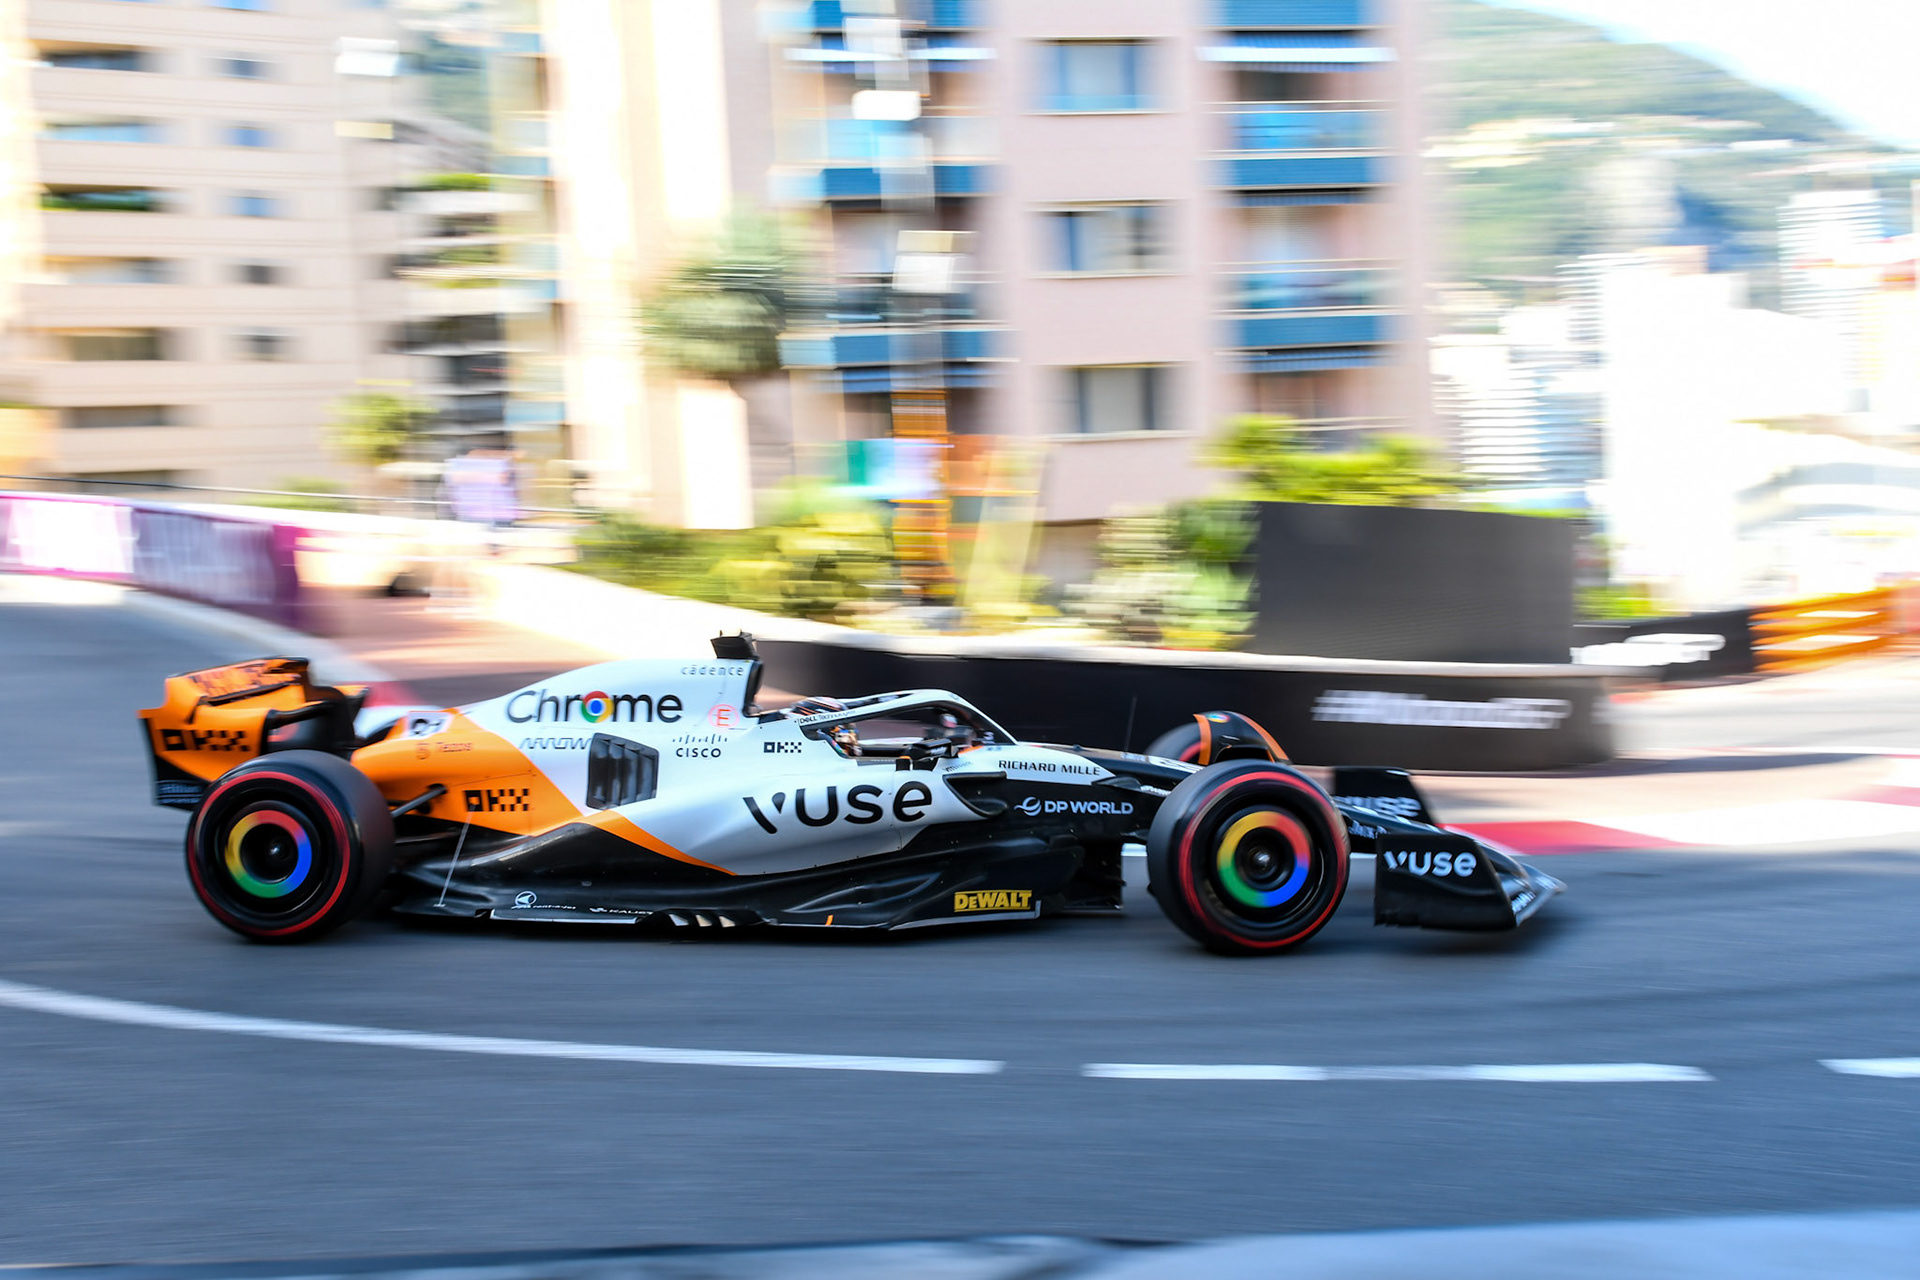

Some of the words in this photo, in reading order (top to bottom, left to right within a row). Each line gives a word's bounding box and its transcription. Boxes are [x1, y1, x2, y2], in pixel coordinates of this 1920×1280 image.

[507, 689, 683, 723] Chrome
[160, 719, 250, 751] OKX
[675, 747, 722, 758] CISCO
[763, 741, 802, 753] OKX
[998, 760, 1056, 773] RICHARD
[1061, 764, 1100, 776] MILLE
[463, 788, 529, 812] OKX
[1044, 801, 1069, 814] DP
[1070, 802, 1134, 815] WORLD
